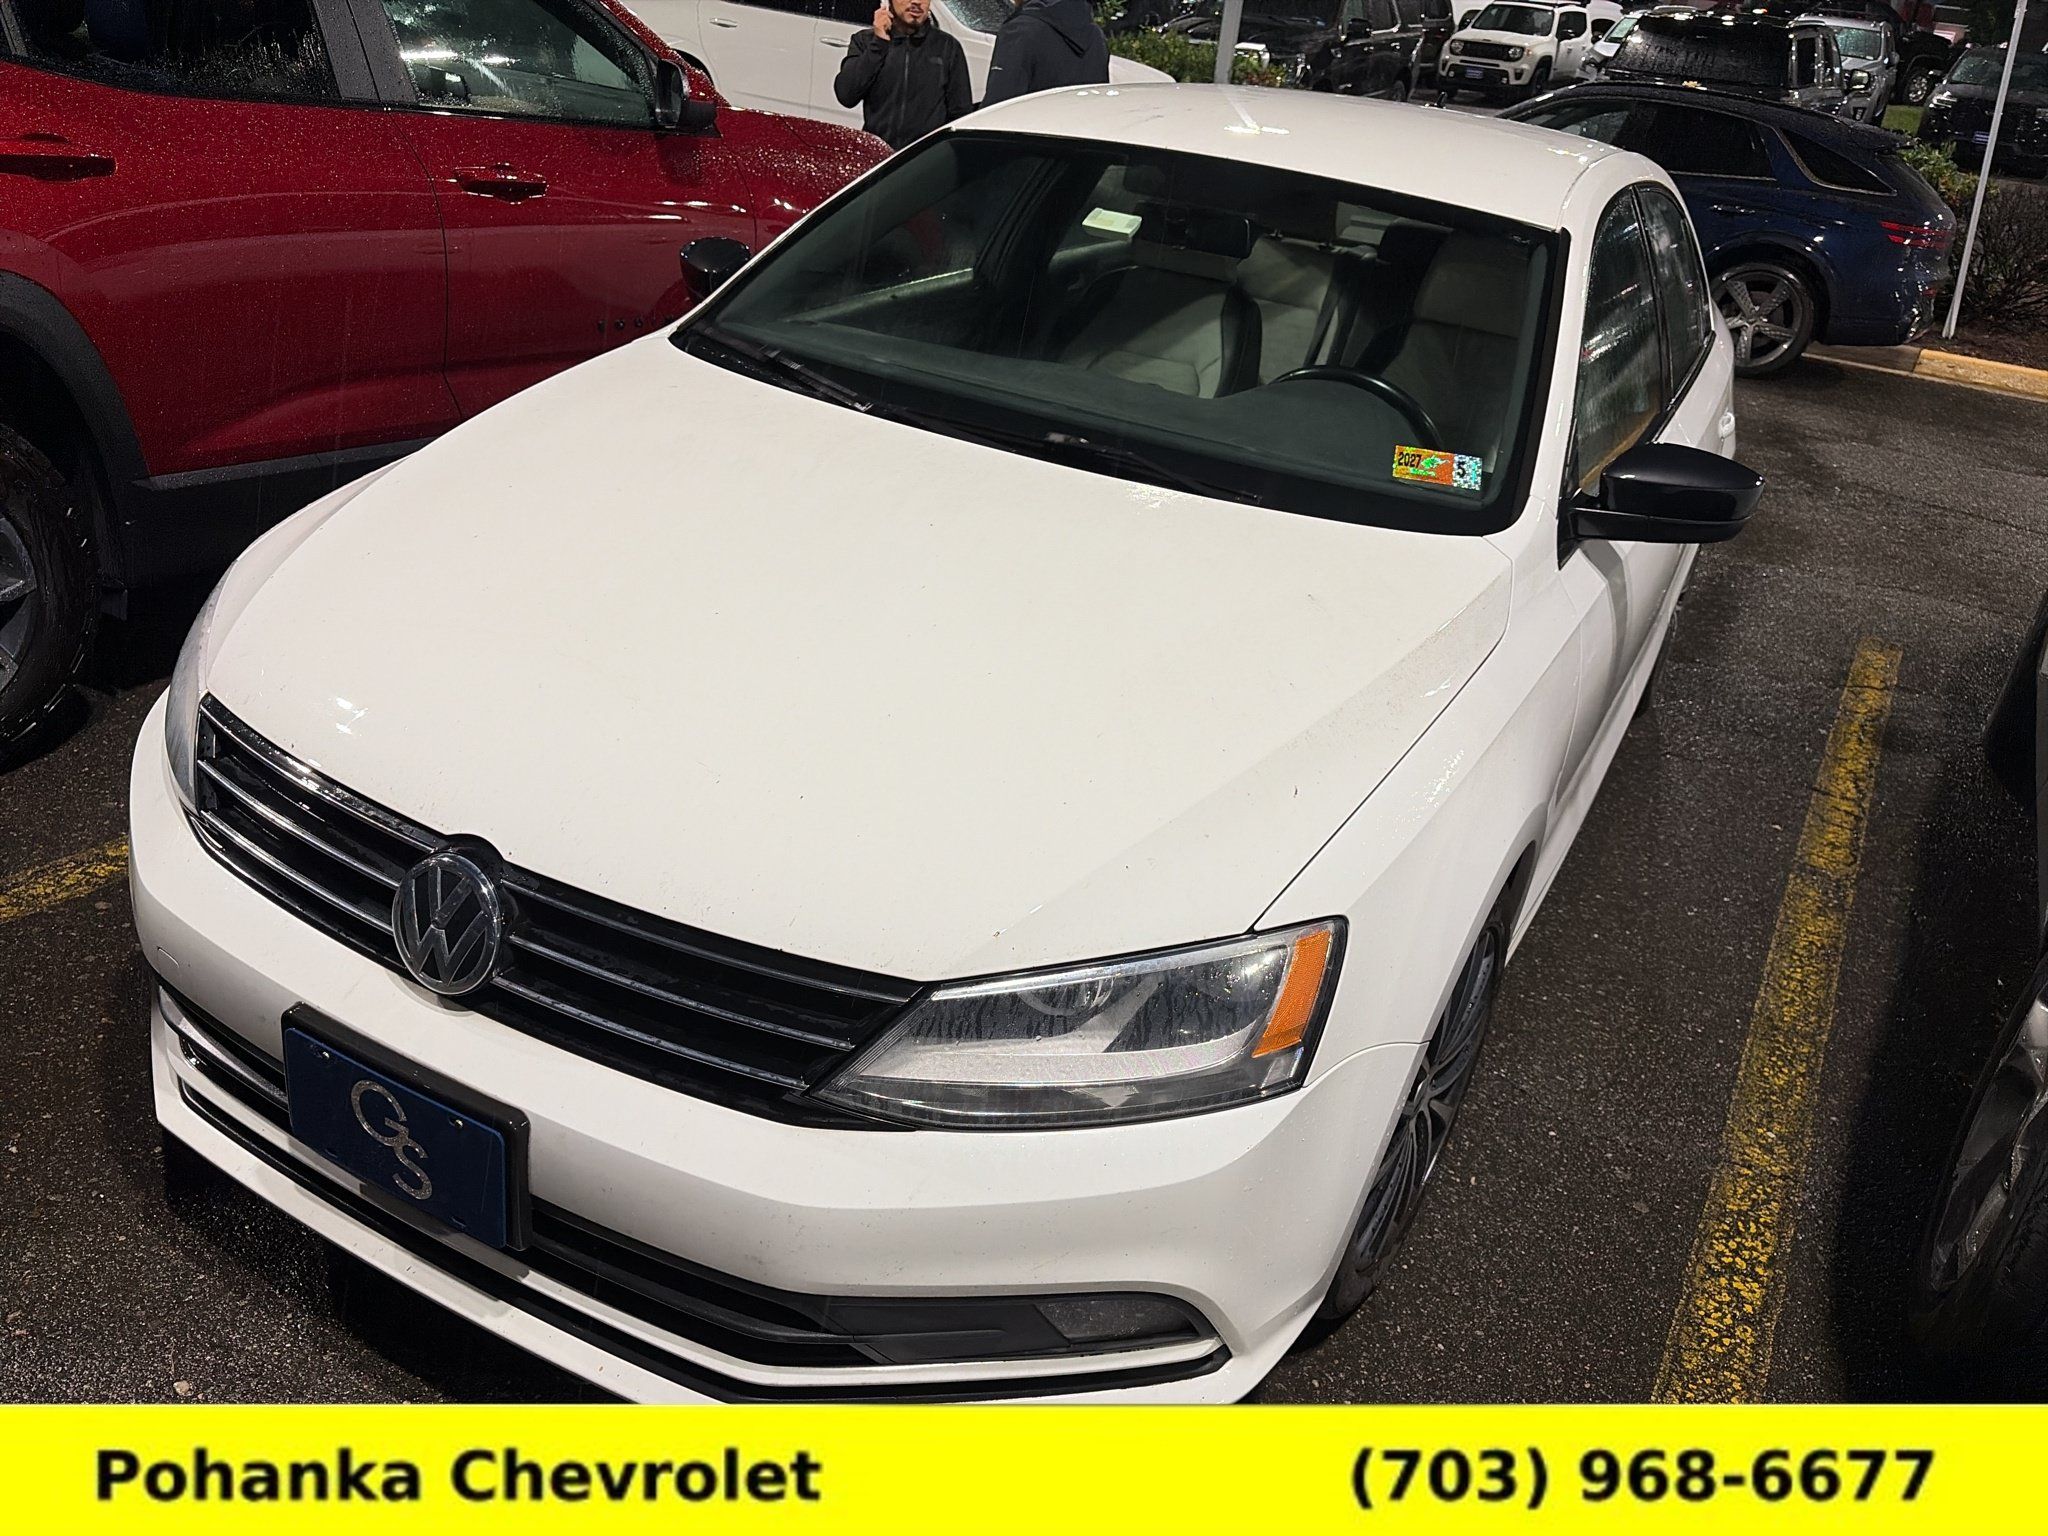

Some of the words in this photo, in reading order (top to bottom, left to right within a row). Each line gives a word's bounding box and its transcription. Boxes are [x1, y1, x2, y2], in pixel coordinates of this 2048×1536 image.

[1398, 451, 1422, 468] 2027
[1456, 460, 1467, 478] 5
[397, 856, 497, 991] VW
